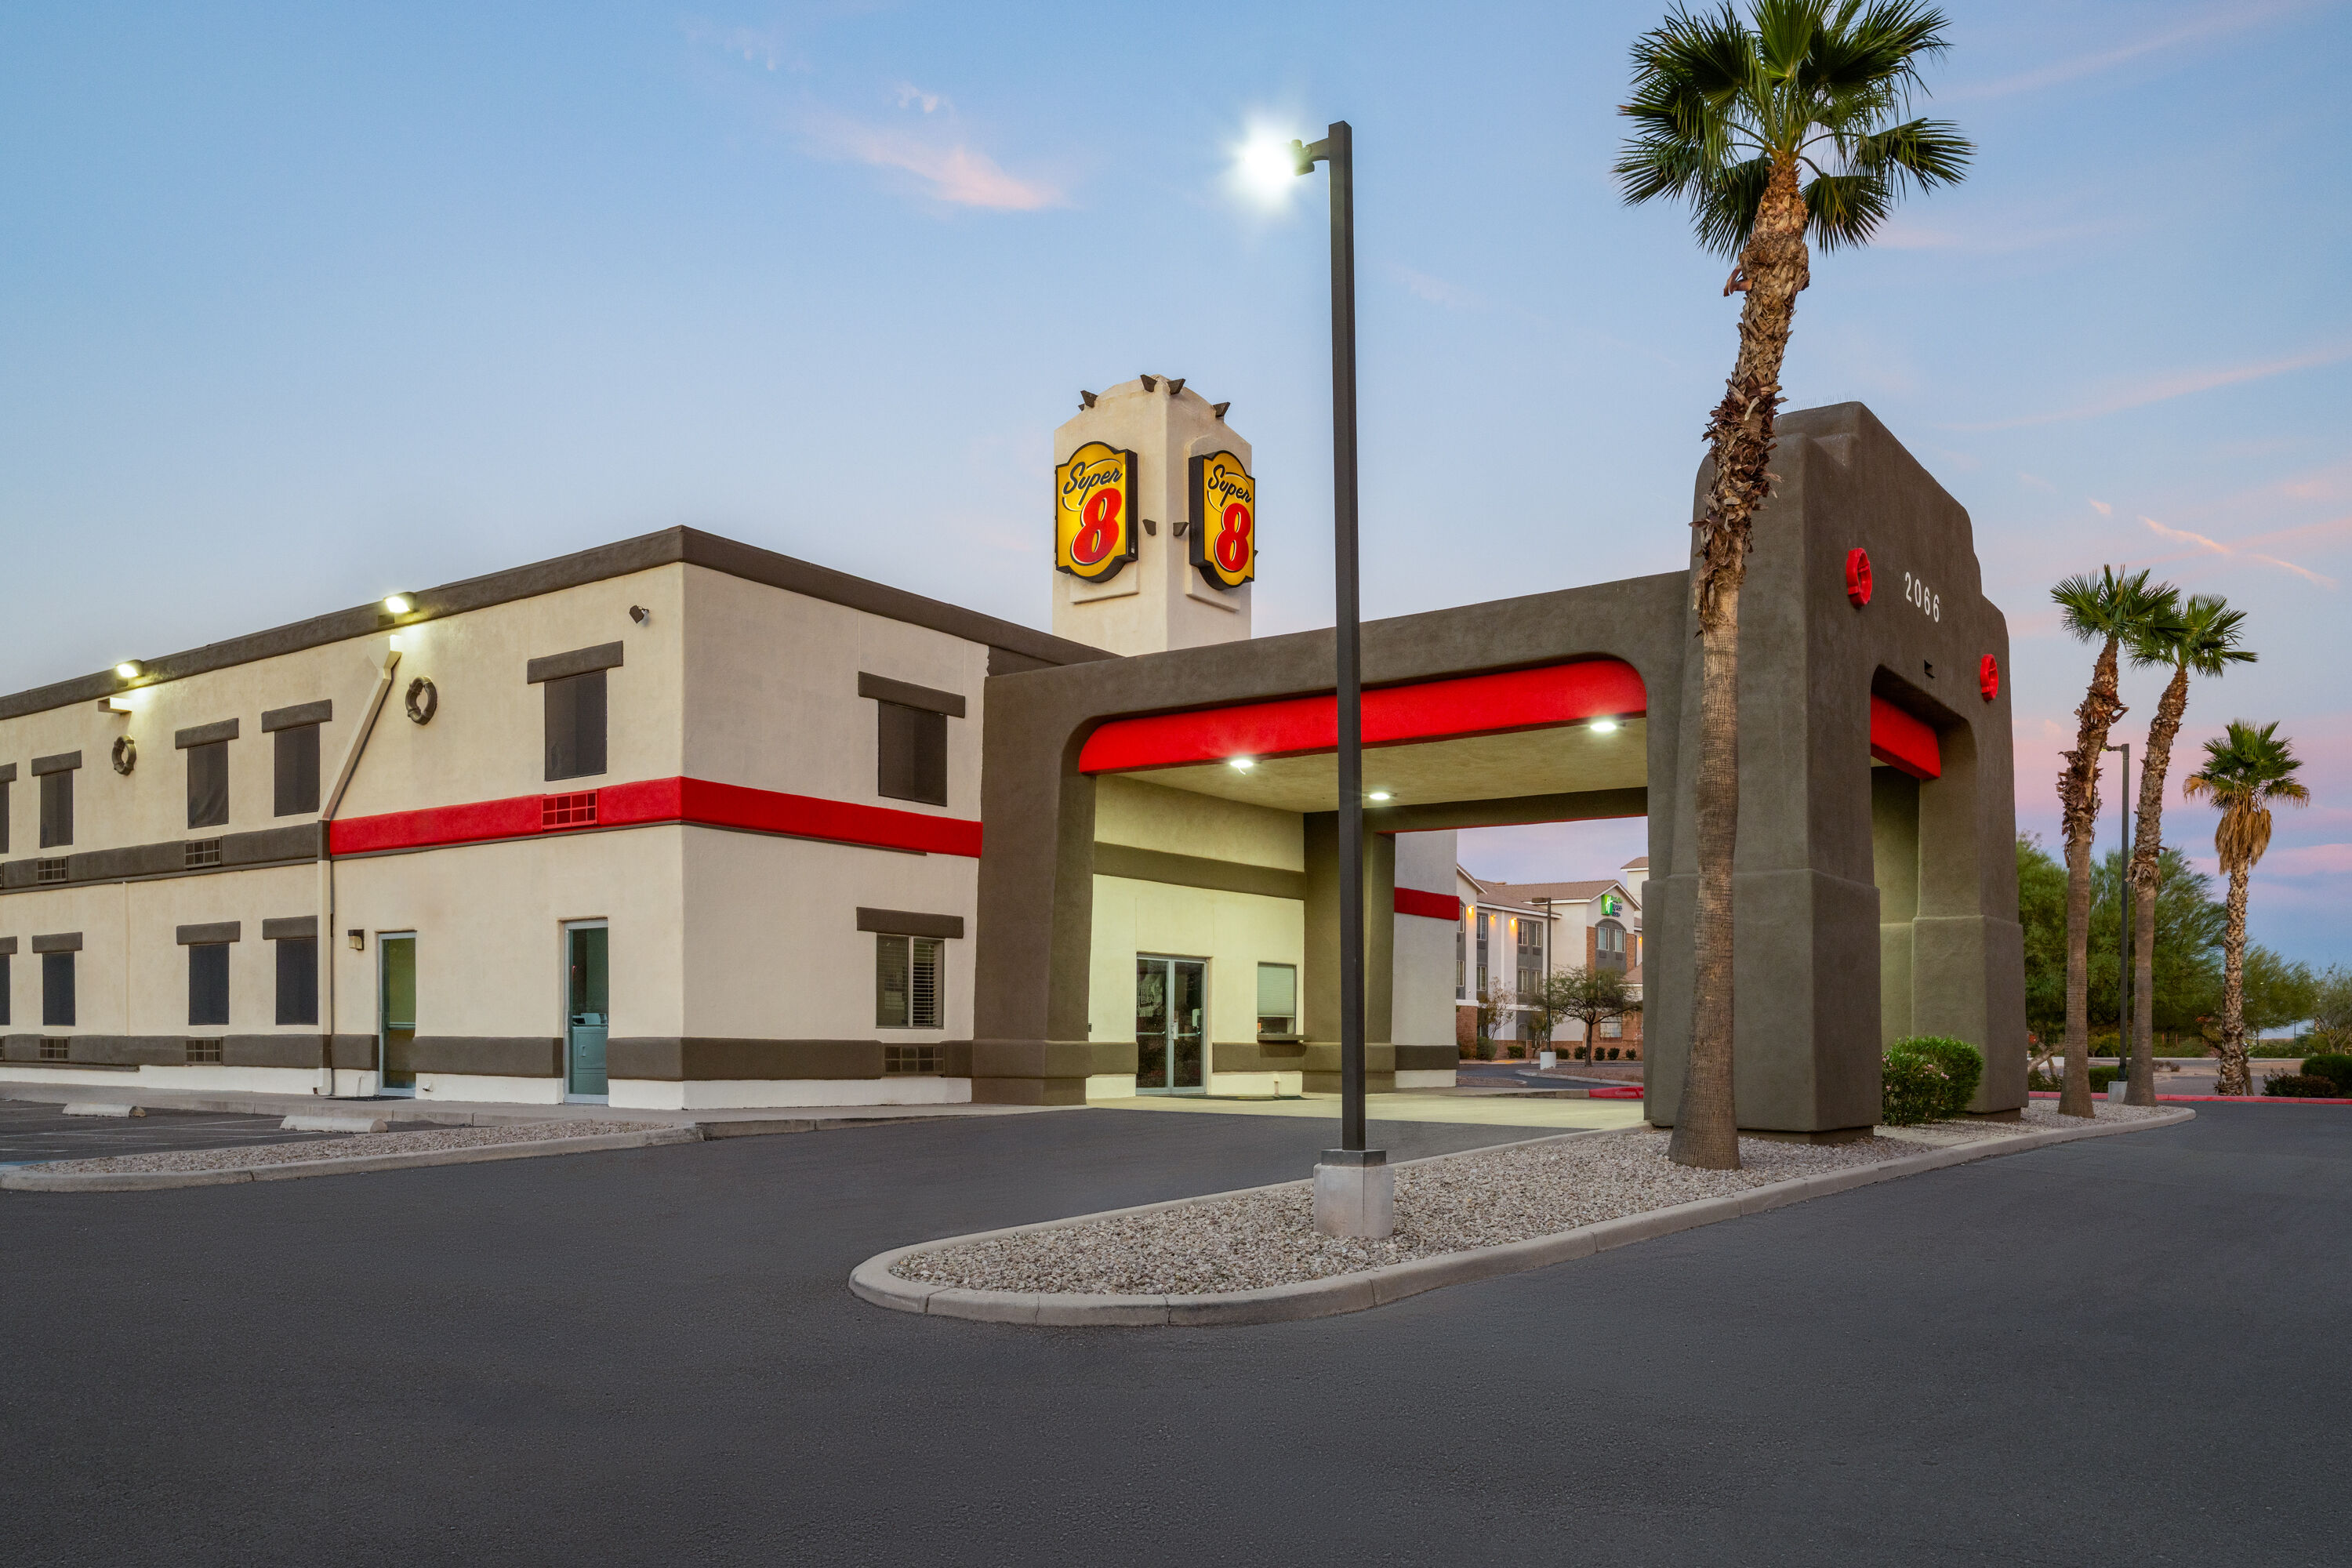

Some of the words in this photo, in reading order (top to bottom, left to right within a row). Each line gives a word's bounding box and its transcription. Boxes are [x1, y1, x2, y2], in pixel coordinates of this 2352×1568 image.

[1062, 461, 1123, 506] Super
[1207, 464, 1252, 508] Super
[1071, 488, 1122, 565] 8
[1214, 503, 1251, 572] 8
[1904, 572, 1940, 622] 2066
